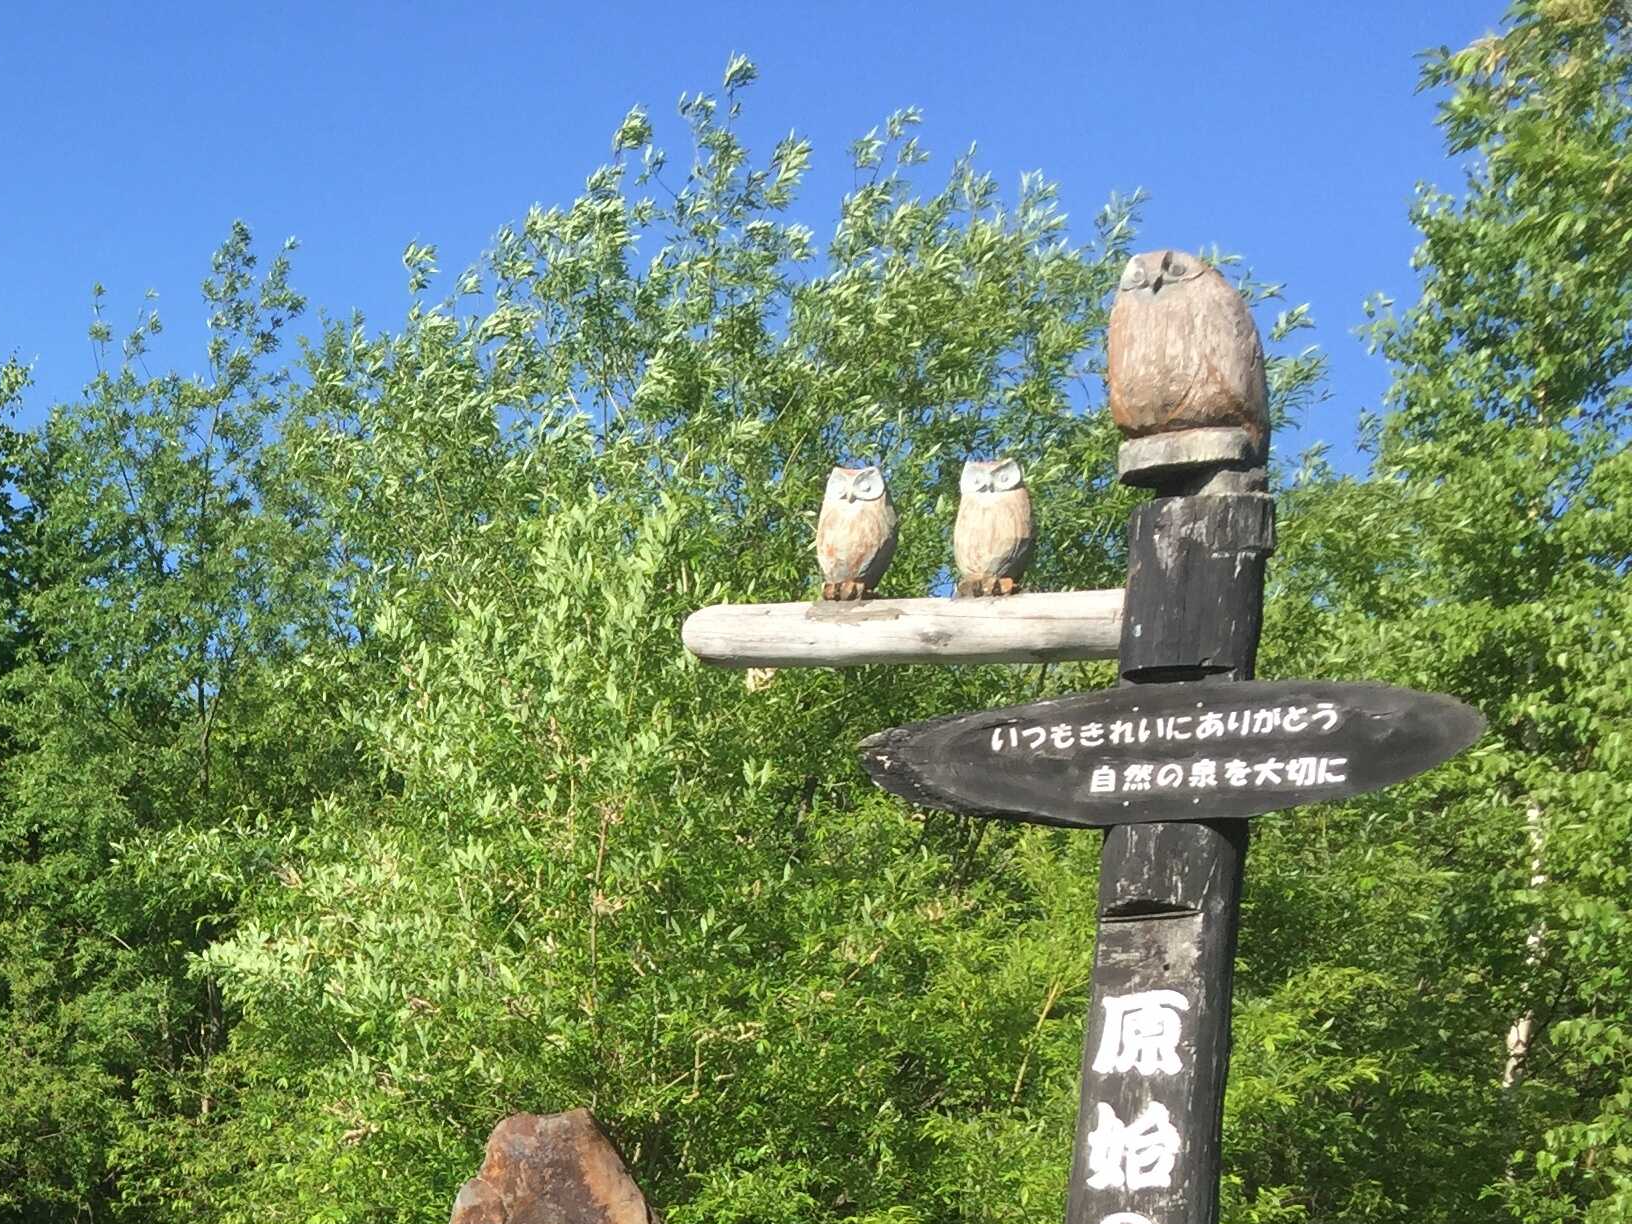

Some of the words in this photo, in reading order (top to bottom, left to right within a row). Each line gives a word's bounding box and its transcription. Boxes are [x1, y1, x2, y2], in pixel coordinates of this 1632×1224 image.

[991, 702, 1338, 751] いつもきれいにありがとう
[1089, 756, 1348, 793] 自然の泉を大切に
